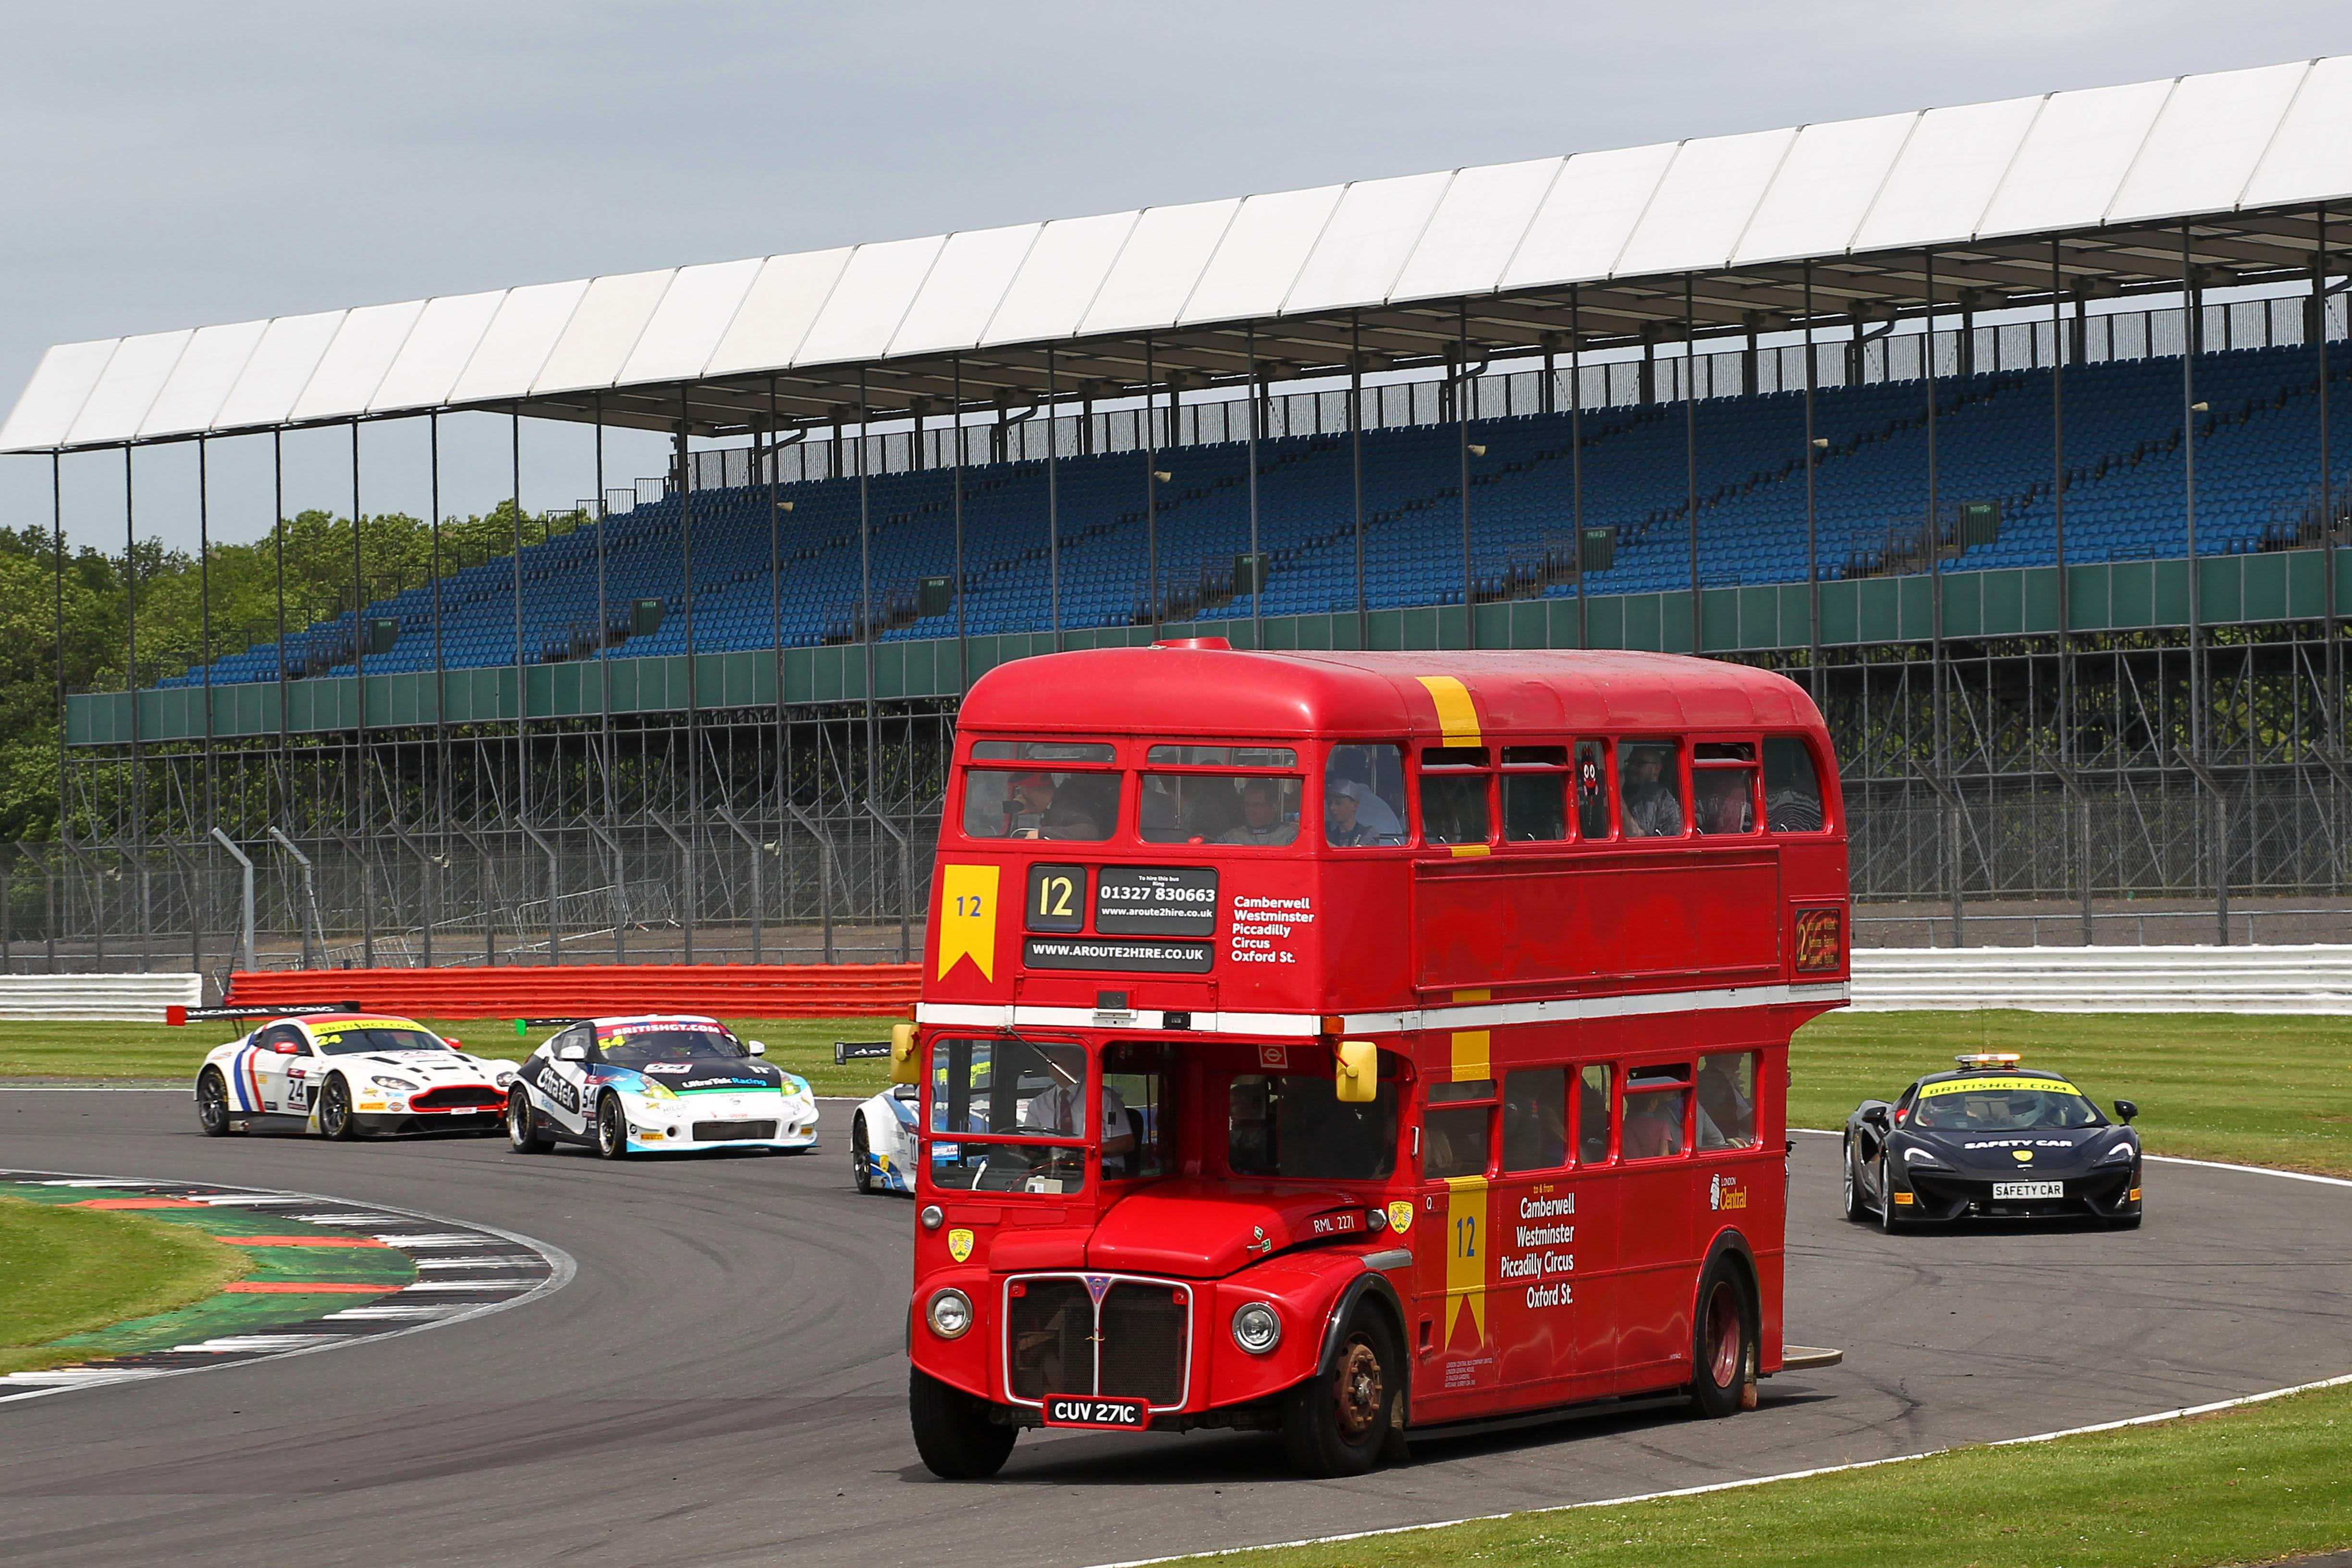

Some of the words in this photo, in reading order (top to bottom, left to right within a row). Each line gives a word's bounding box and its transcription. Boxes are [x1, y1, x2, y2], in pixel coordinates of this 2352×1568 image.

[1040, 877, 1073, 916] 12
[1101, 886, 1151, 899] 01327
[1155, 888, 1215, 902] 830663
[956, 896, 981, 917] 12
[1234, 896, 1310, 909] Camberwell
[1102, 907, 1212, 917] www.aroute2hire.co.uk
[1234, 909, 1314, 922] Westminster
[1232, 923, 1291, 938] Piccadilly
[1232, 937, 1270, 948] Circus
[1033, 944, 1203, 959] WWW.AROUTE2HIRE.CO.UK
[1231, 950, 1275, 962] Oxford
[1279, 951, 1296, 963] St.
[186, 1008, 269, 1016] MACMILLAN
[612, 1024, 720, 1036] BRITISHGT.COM
[318, 1034, 343, 1046] 24
[598, 1035, 625, 1051] 54
[289, 1080, 303, 1101] 24
[537, 1066, 575, 1109] UltraTek
[1930, 1083, 2067, 1095] BRITISHGT.COM
[583, 1086, 597, 1109] 54
[910, 1137, 917, 1162] 11
[1964, 1140, 2033, 1149] SAFETY
[1533, 1186, 1538, 1194] to
[1544, 1183, 1554, 1192] from
[1721, 1177, 1736, 1186] LONDON
[1720, 1186, 1746, 1210] Central
[1996, 1186, 2037, 1196] SAFETY
[2040, 1185, 2061, 1195] CAR
[1520, 1193, 1575, 1219] Camberwell
[1314, 1220, 1334, 1233] RML
[1337, 1216, 1355, 1230] 2271
[1457, 1216, 1475, 1258] 12
[1516, 1223, 1574, 1247] Westminster
[1501, 1253, 1542, 1279] Piccadilly
[1544, 1251, 1573, 1273] Circus
[1527, 1284, 1558, 1309] Oxford
[1561, 1283, 1573, 1305] St.
[1055, 1403, 1091, 1420] CUV
[1096, 1404, 1135, 1423] 271C
